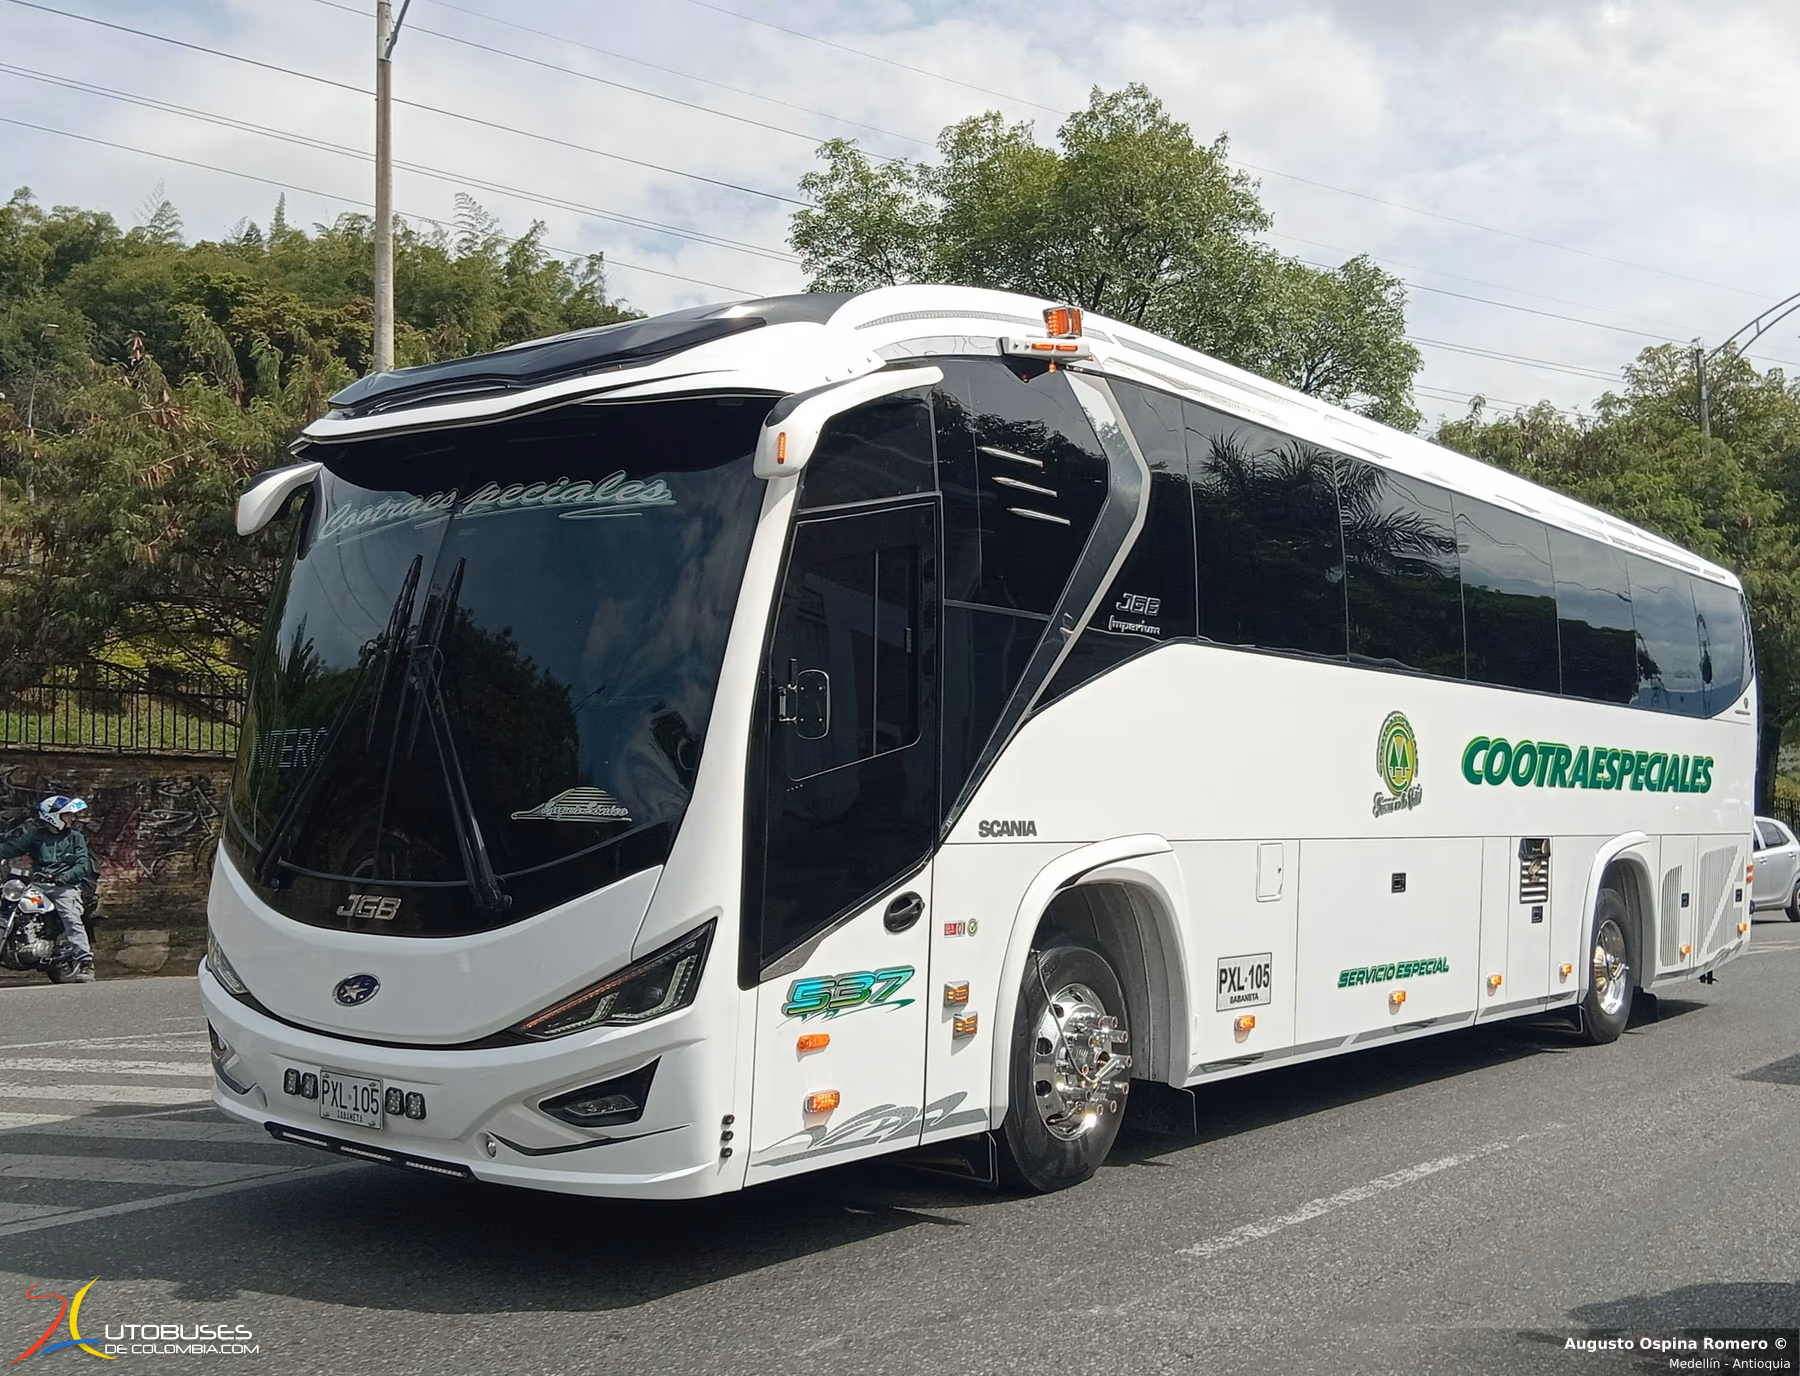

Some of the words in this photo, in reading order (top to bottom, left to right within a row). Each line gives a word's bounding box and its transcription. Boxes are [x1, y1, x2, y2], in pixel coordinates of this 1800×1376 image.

[1115, 592, 1161, 616] JGB
[1108, 615, 1161, 635] Imperium
[1461, 736, 1714, 794] COOTRAESPECIALES
[978, 820, 1037, 838] SCANIA
[336, 894, 402, 921] JGB
[1337, 963, 1395, 988] SERVICIO
[1395, 956, 1450, 980] ESPECIAL
[781, 964, 916, 1018] 537
[1229, 992, 1259, 1004] SABANETA
